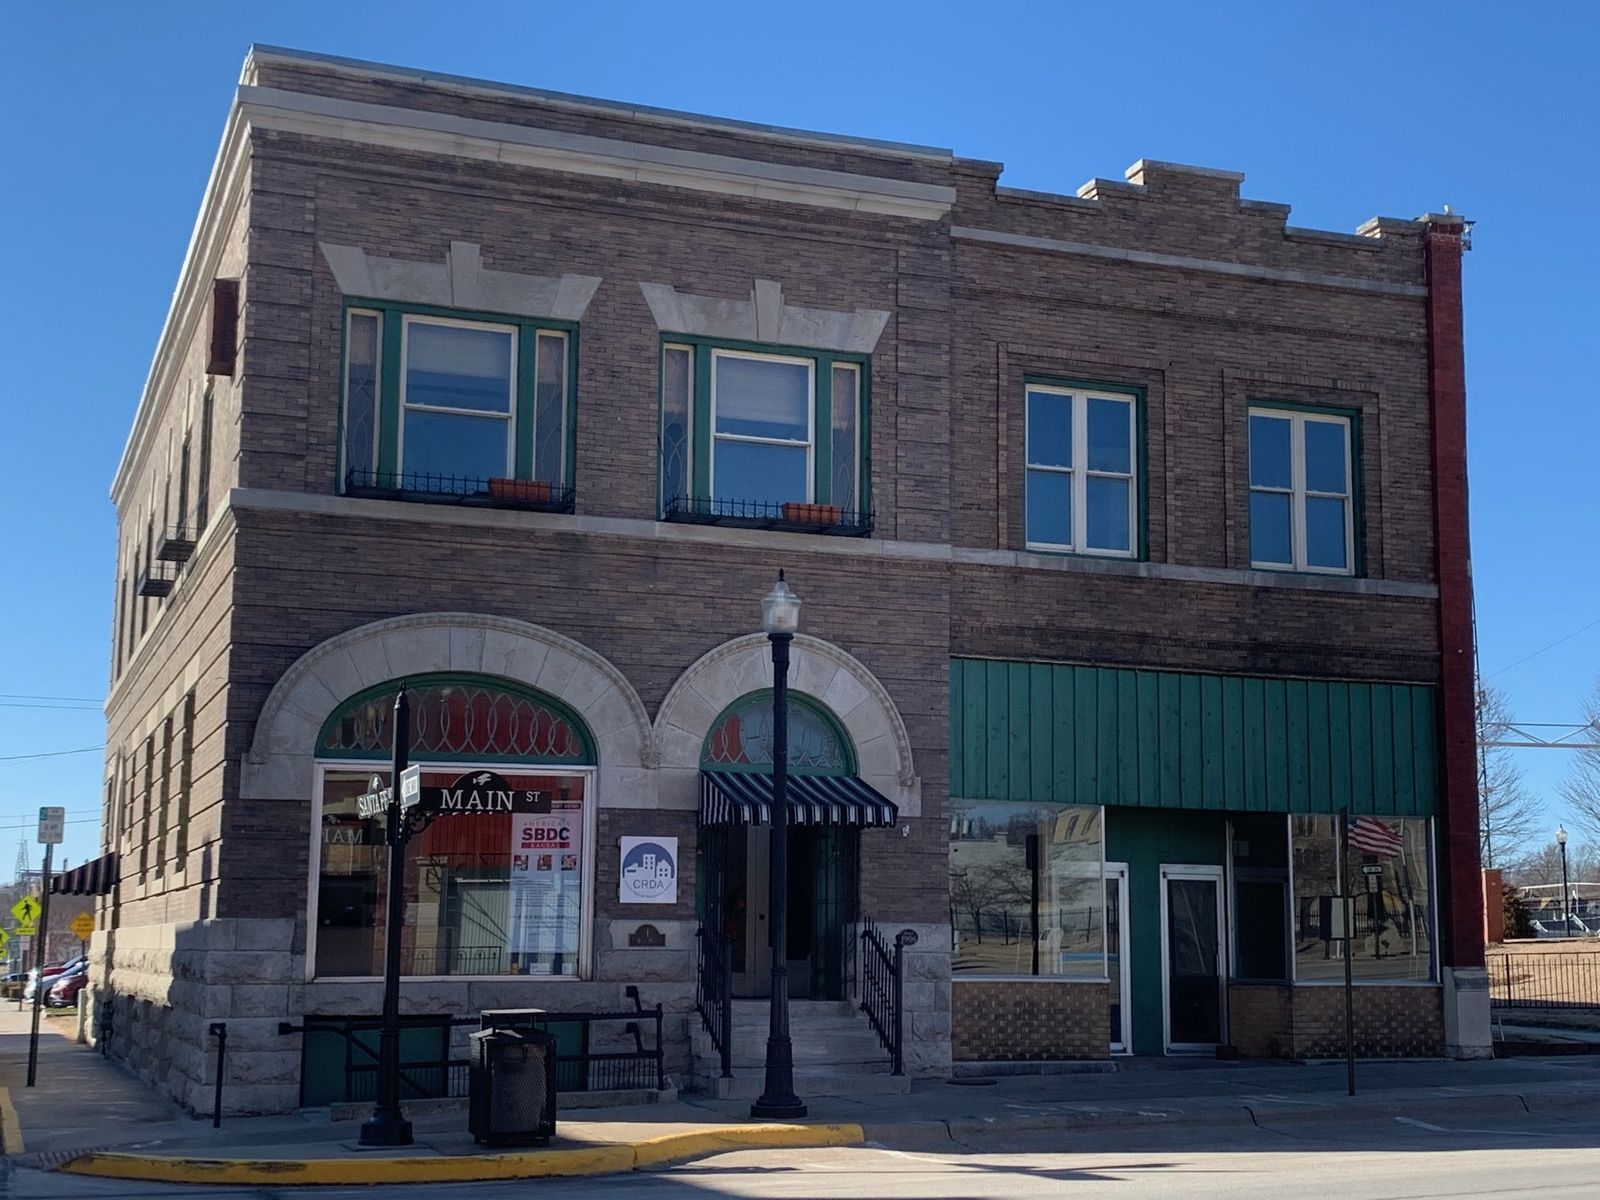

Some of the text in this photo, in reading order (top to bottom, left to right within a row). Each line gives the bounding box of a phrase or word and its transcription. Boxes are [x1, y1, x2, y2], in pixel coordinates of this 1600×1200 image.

[358, 793, 381, 817] SANTA
[440, 788, 541, 811] MAIN ST
[521, 827, 570, 841] SBDC
[633, 879, 665, 889] CRDA
